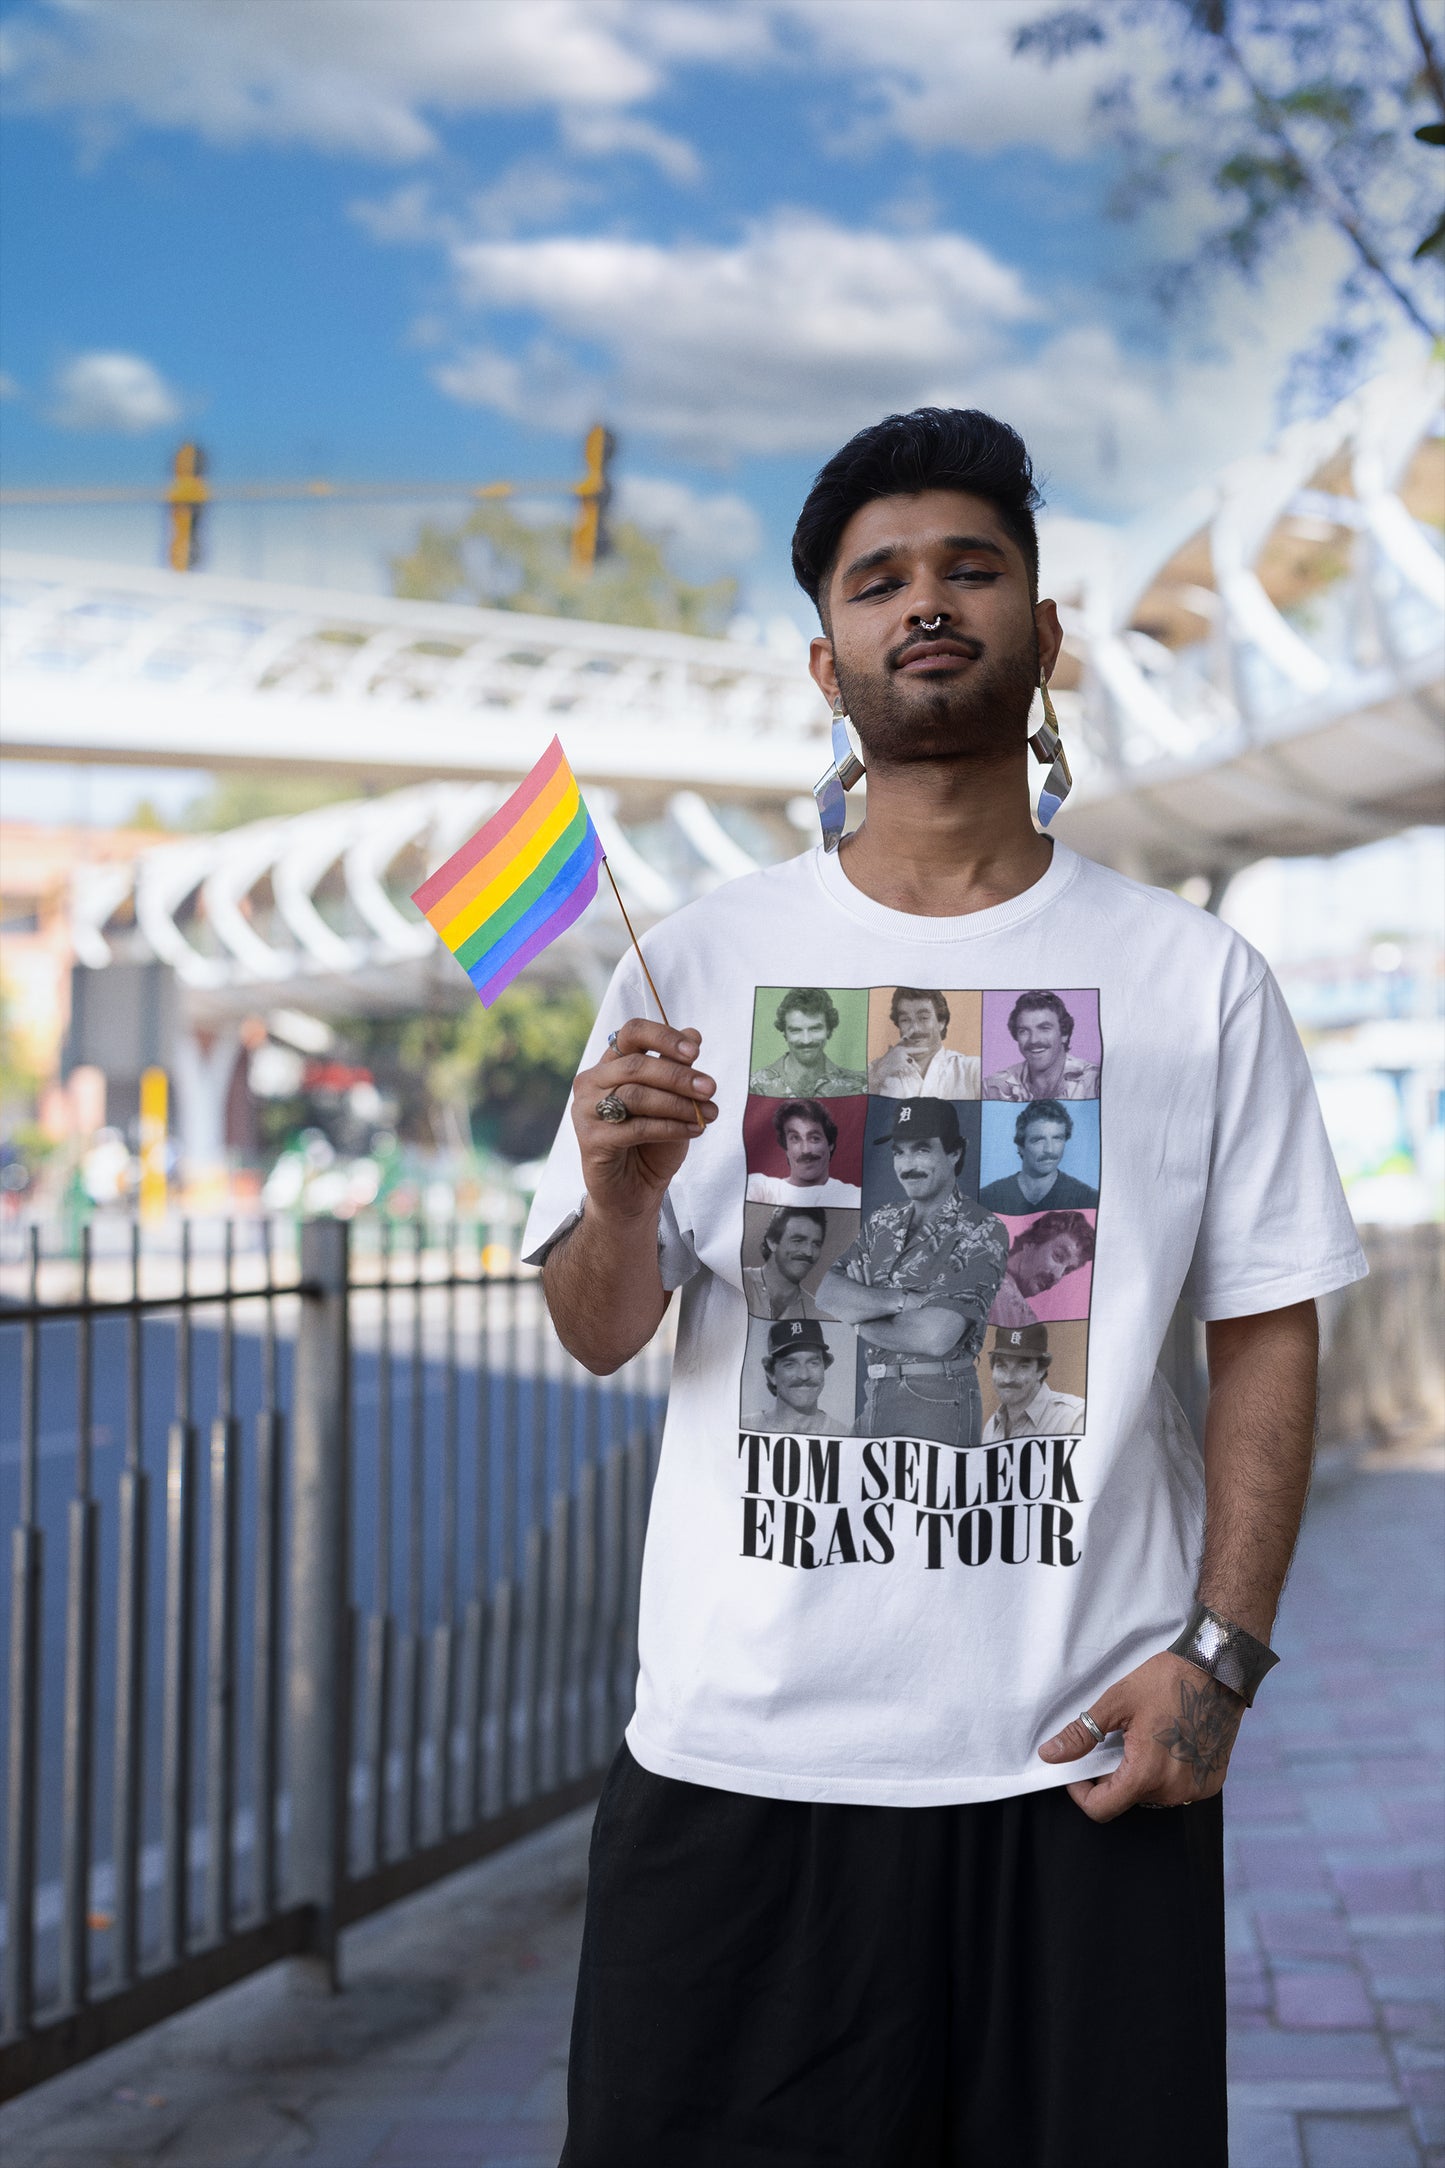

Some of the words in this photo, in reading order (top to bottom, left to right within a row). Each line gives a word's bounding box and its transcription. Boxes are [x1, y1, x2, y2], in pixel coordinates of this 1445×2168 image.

[738, 1433, 843, 1504] TOM
[861, 1438, 1084, 1510] SELLECK
[739, 1496, 895, 1570] ERAS
[916, 1503, 1082, 1570] TOUR
